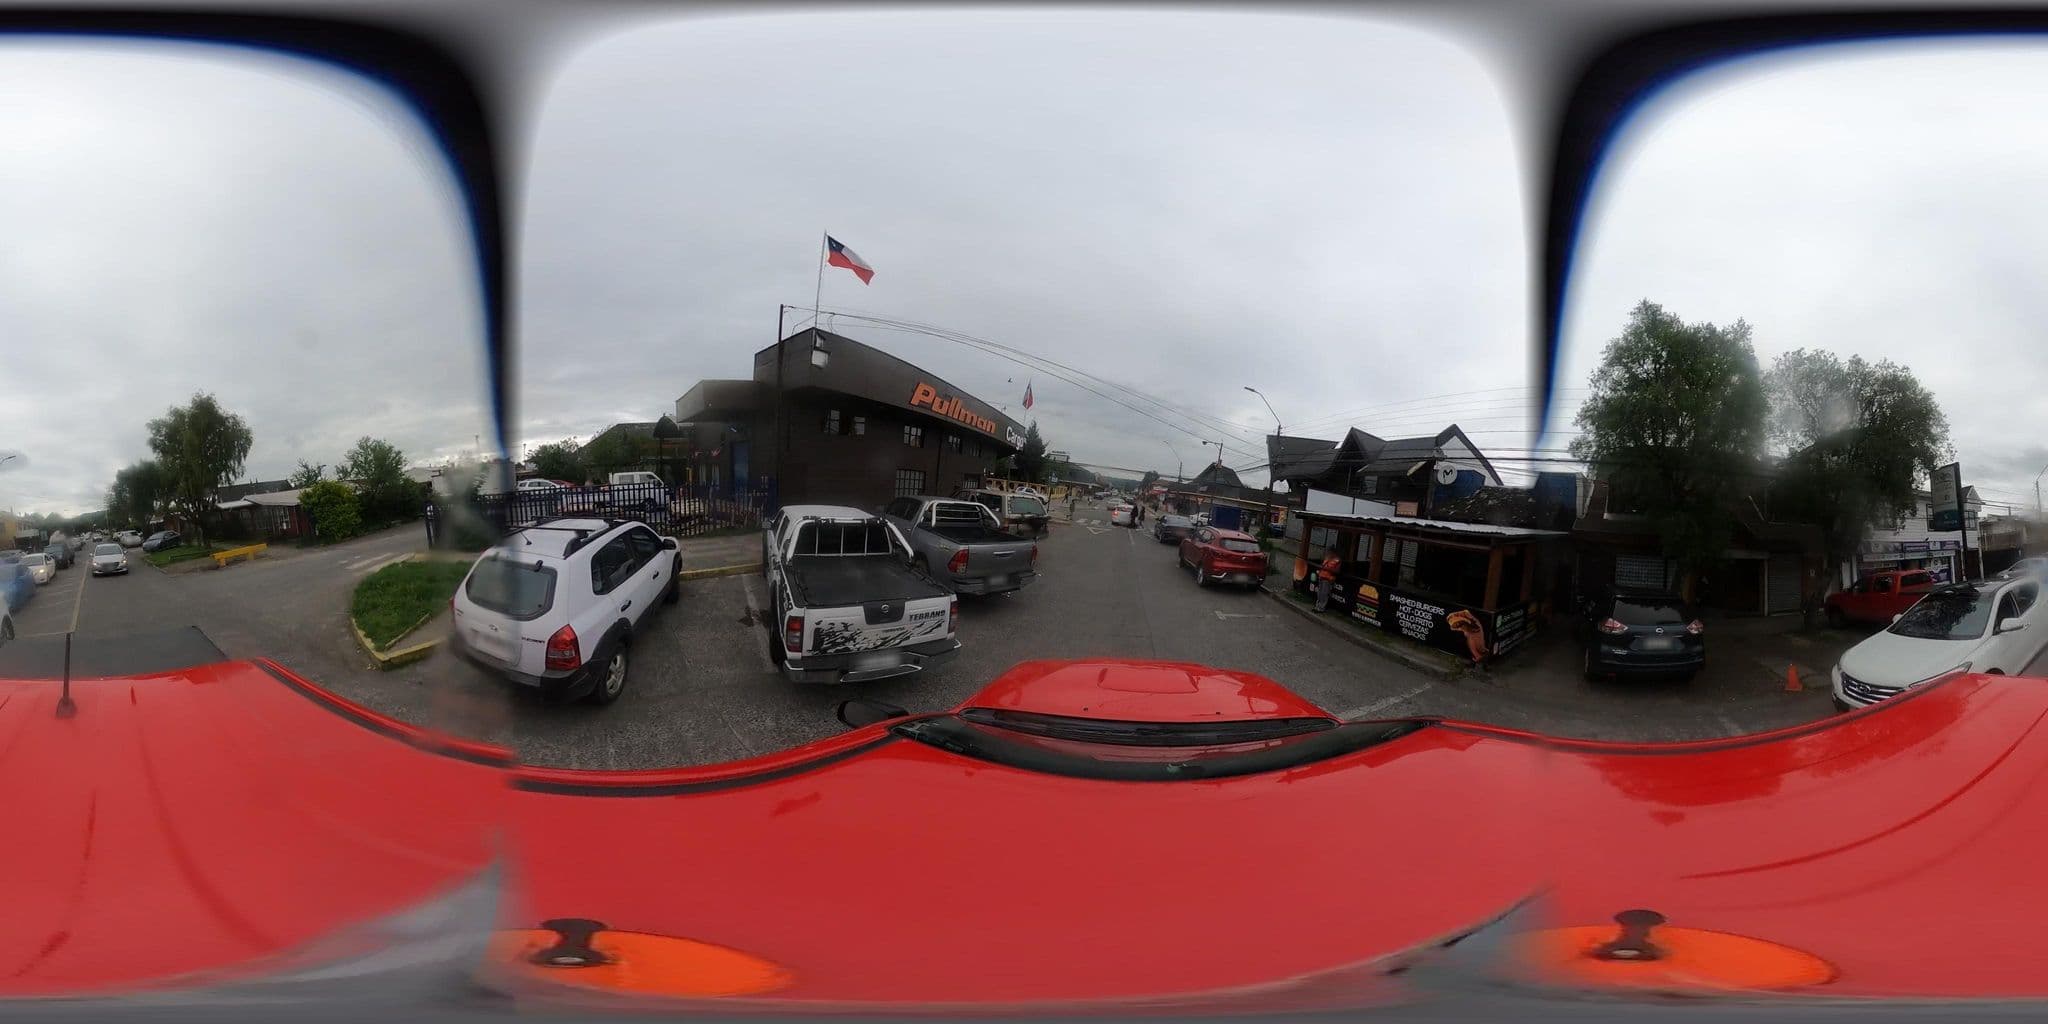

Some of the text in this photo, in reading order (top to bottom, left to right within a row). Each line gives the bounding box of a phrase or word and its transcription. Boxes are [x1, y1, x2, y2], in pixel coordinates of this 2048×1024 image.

[910, 382, 996, 434] Pullman
[1006, 426, 1025, 450] Cargo
[1390, 594, 1444, 615] SMASHED BURGERS
[1396, 611, 1433, 628] POLLO FRITO
[1399, 620, 1429, 634] CERVEZAS
[1402, 628, 1426, 640] SNACKS
